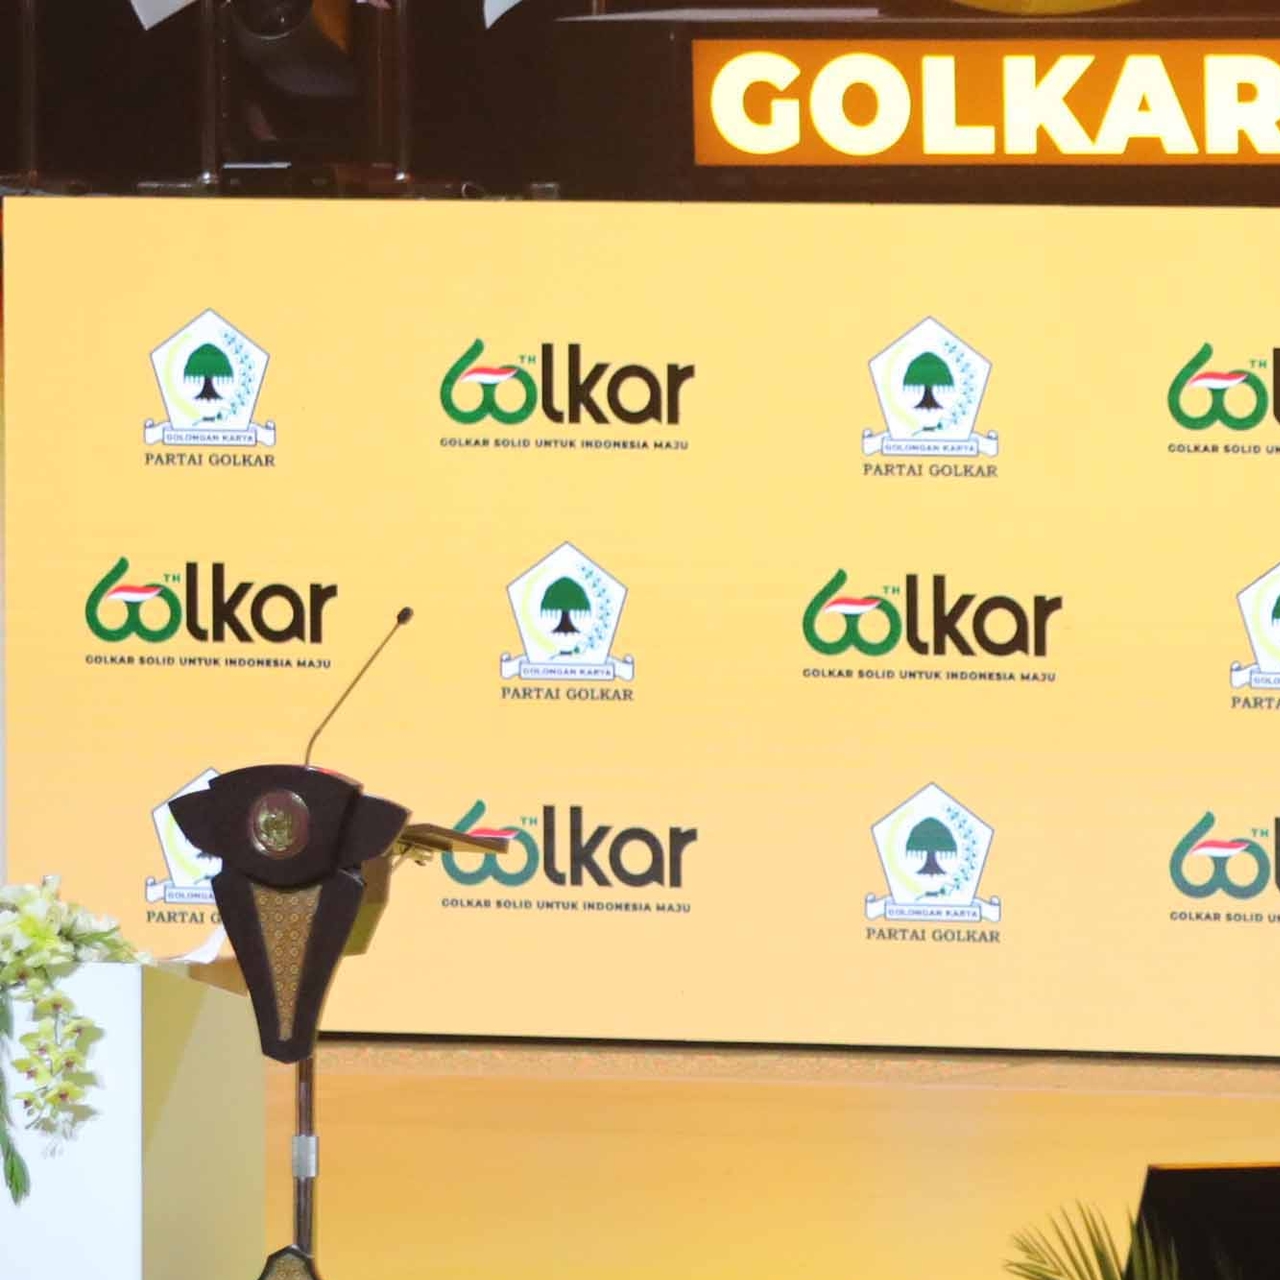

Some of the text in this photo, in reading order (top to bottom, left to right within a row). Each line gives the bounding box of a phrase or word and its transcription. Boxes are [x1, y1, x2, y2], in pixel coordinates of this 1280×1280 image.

[145, 452, 275, 467] PARTAI GOLKAR
[863, 463, 998, 478] PARTAI GOLKAR
[501, 687, 634, 701] PARTAI GOLKAR
[146, 910, 206, 924] PARTAI
[866, 928, 1001, 943] PARTAI GOLKAR
